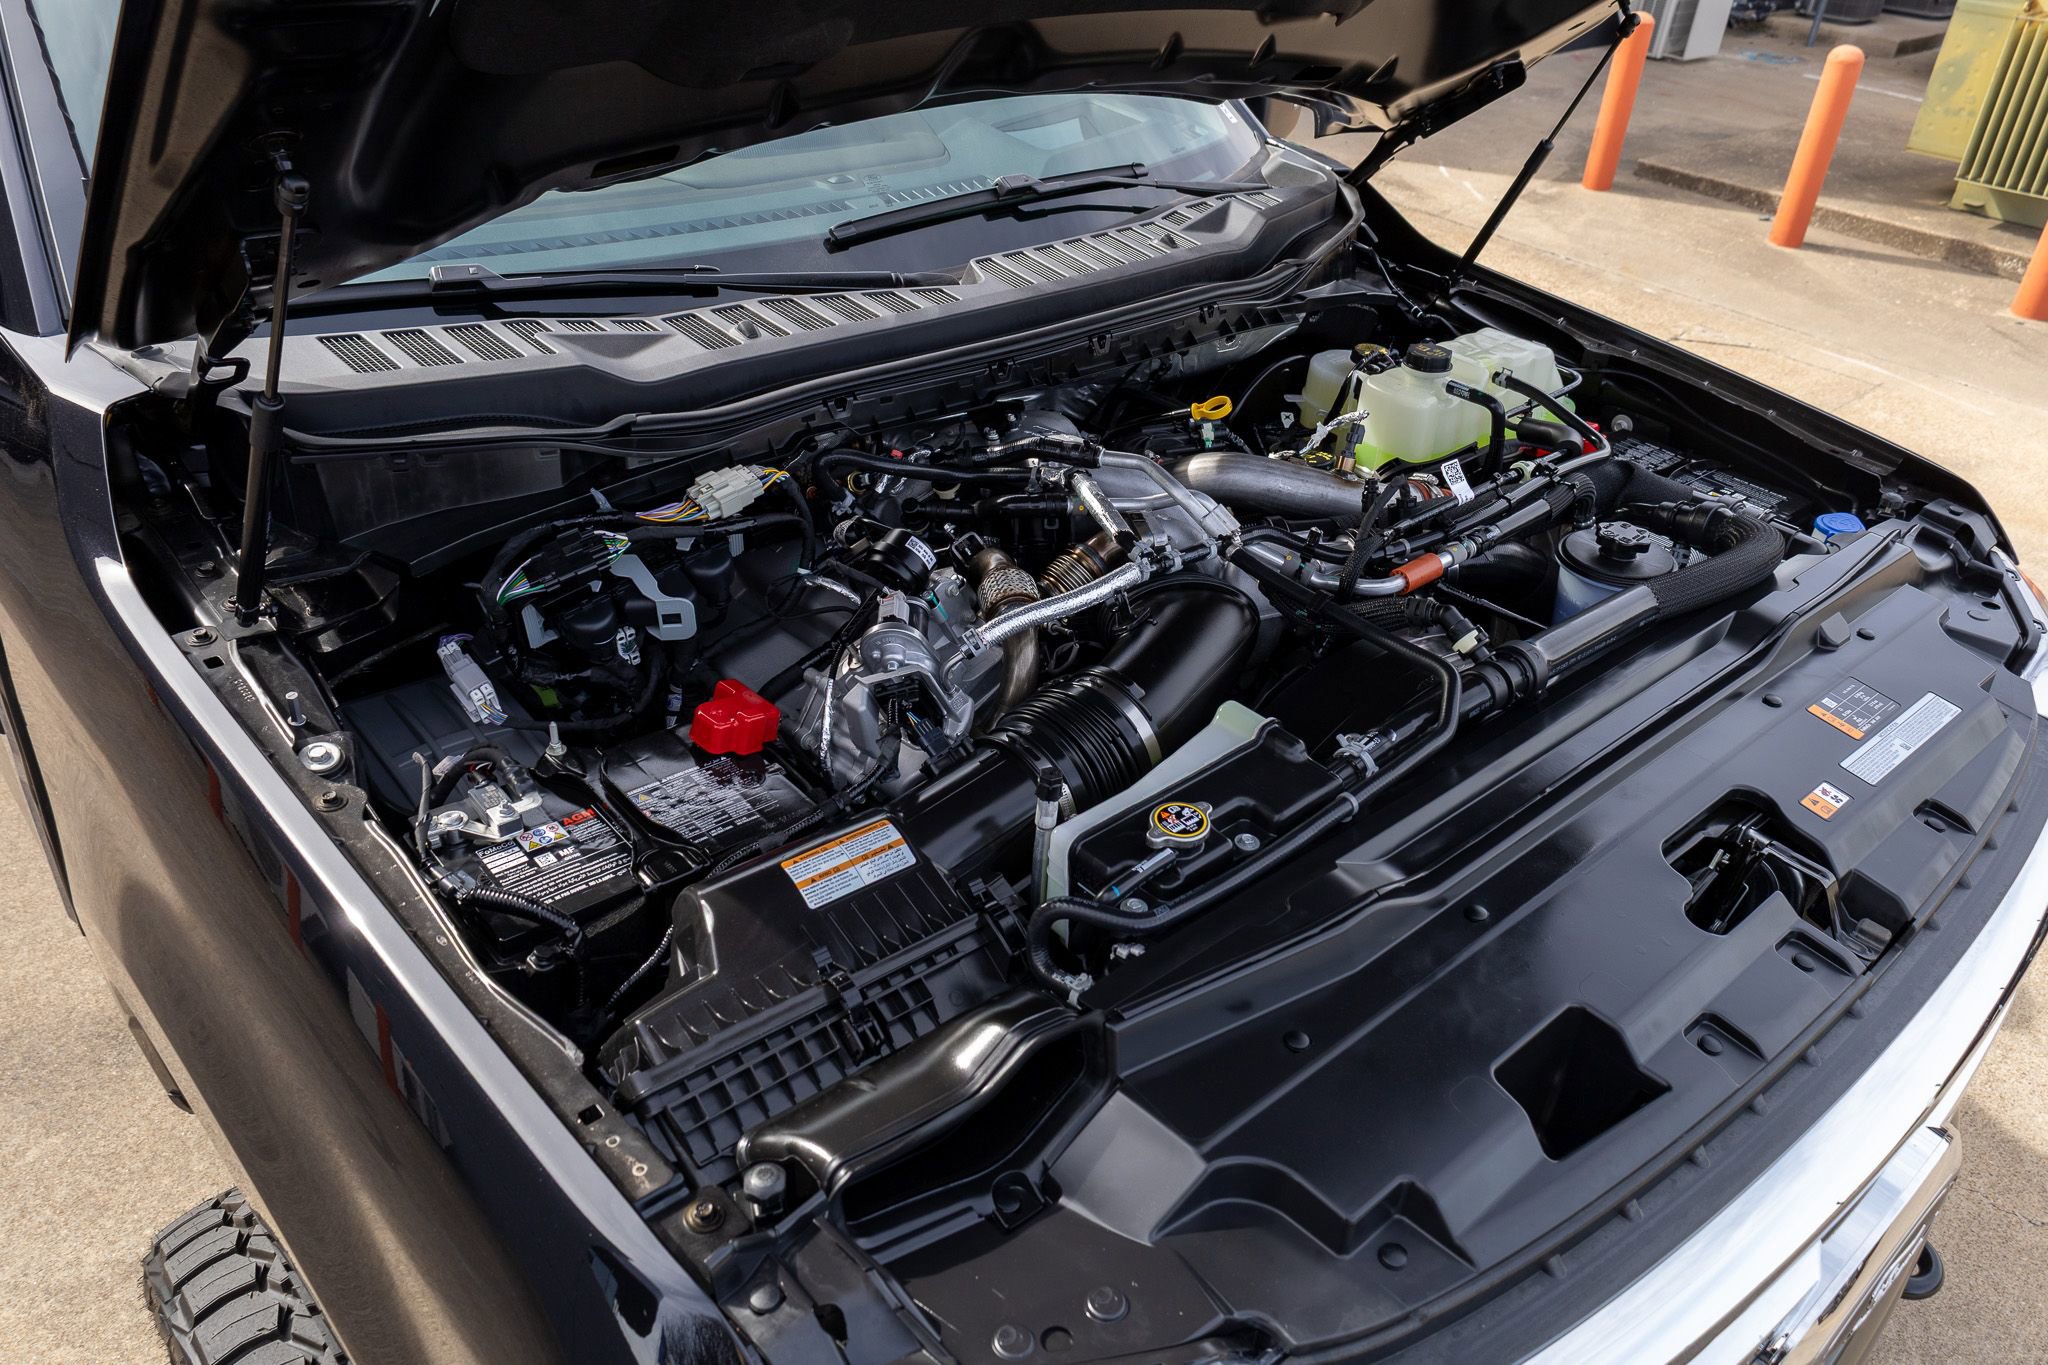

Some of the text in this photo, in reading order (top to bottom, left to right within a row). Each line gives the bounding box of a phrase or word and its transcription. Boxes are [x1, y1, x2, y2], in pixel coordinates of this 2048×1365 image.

[563, 808, 596, 825] AGM
[478, 842, 514, 857] FoMoCo
[558, 845, 575, 857] MF
